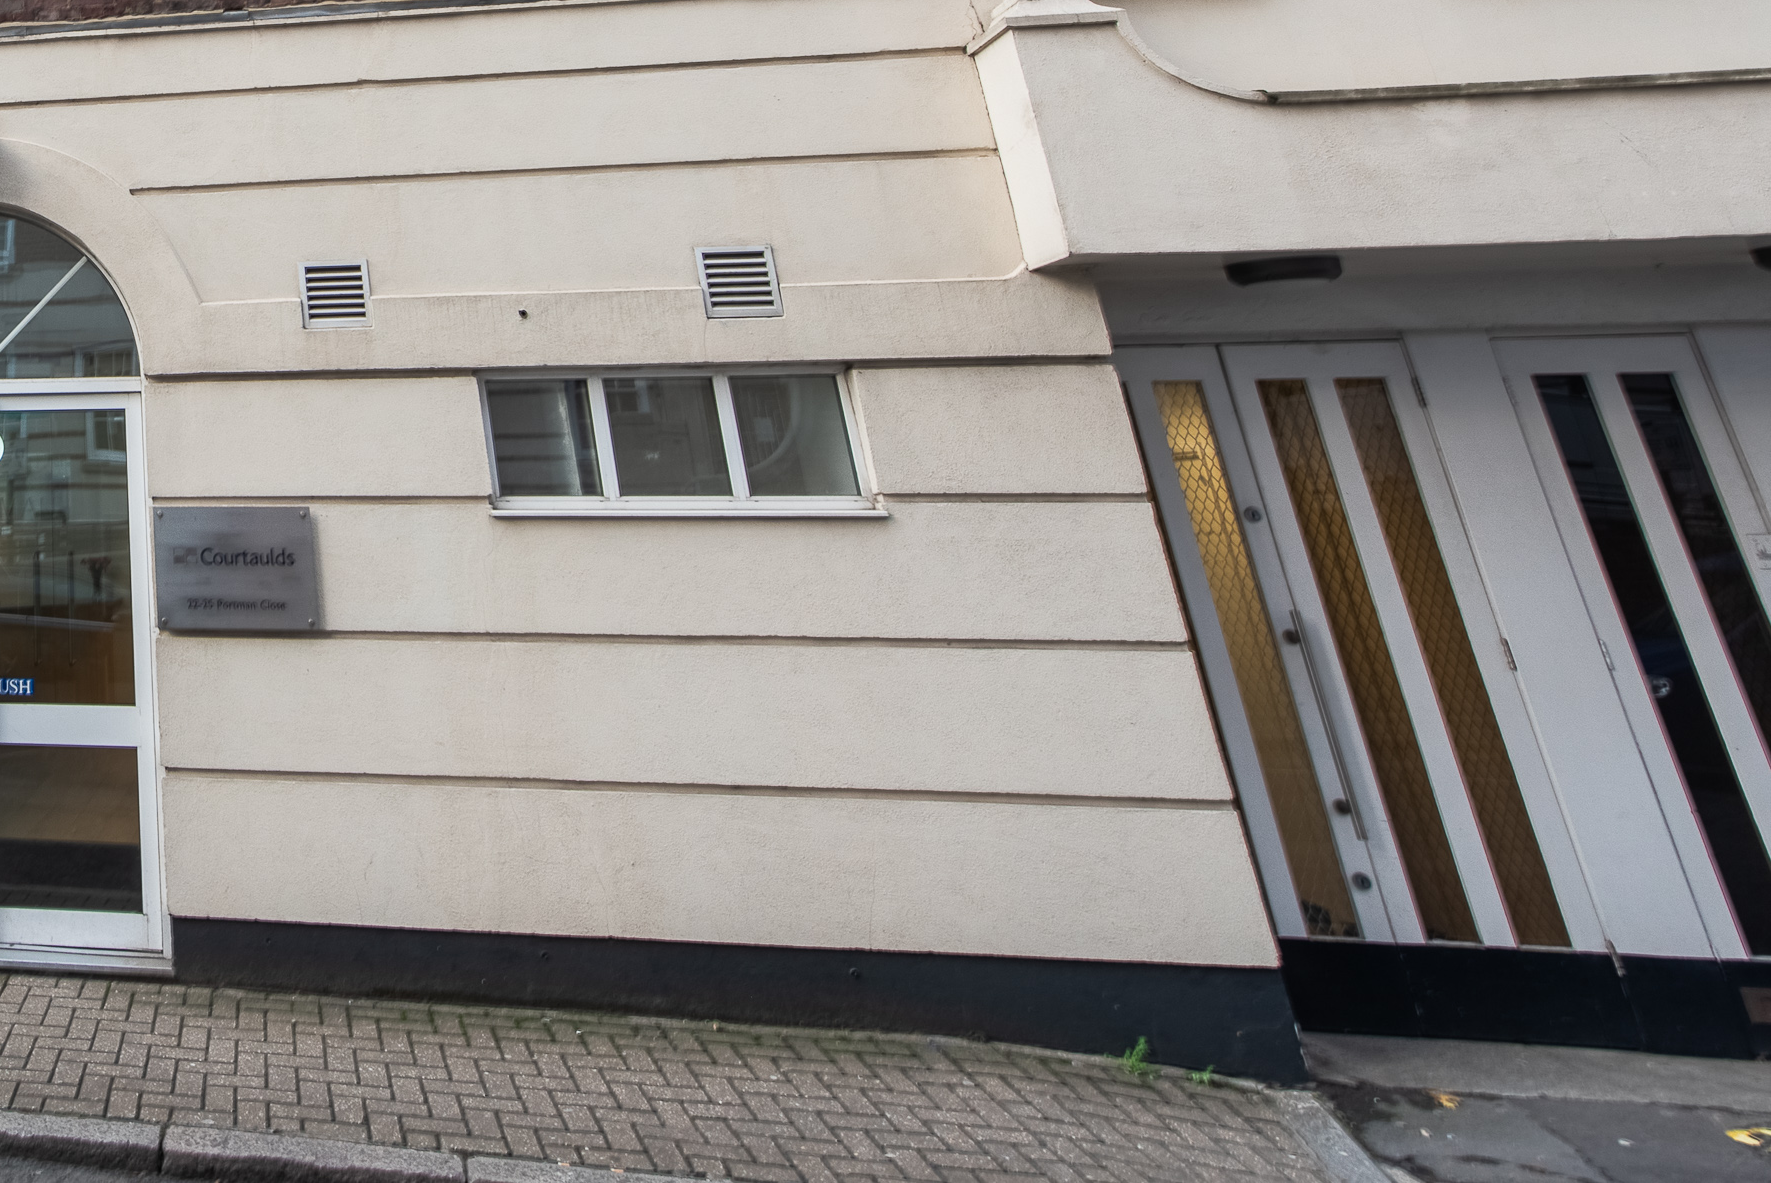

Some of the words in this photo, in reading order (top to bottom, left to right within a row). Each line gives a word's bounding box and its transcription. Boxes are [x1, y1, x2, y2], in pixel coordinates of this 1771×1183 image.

[201, 547, 295, 567] Courtaulds
[216, 598, 256, 611] Portman
[259, 599, 287, 611] Close
